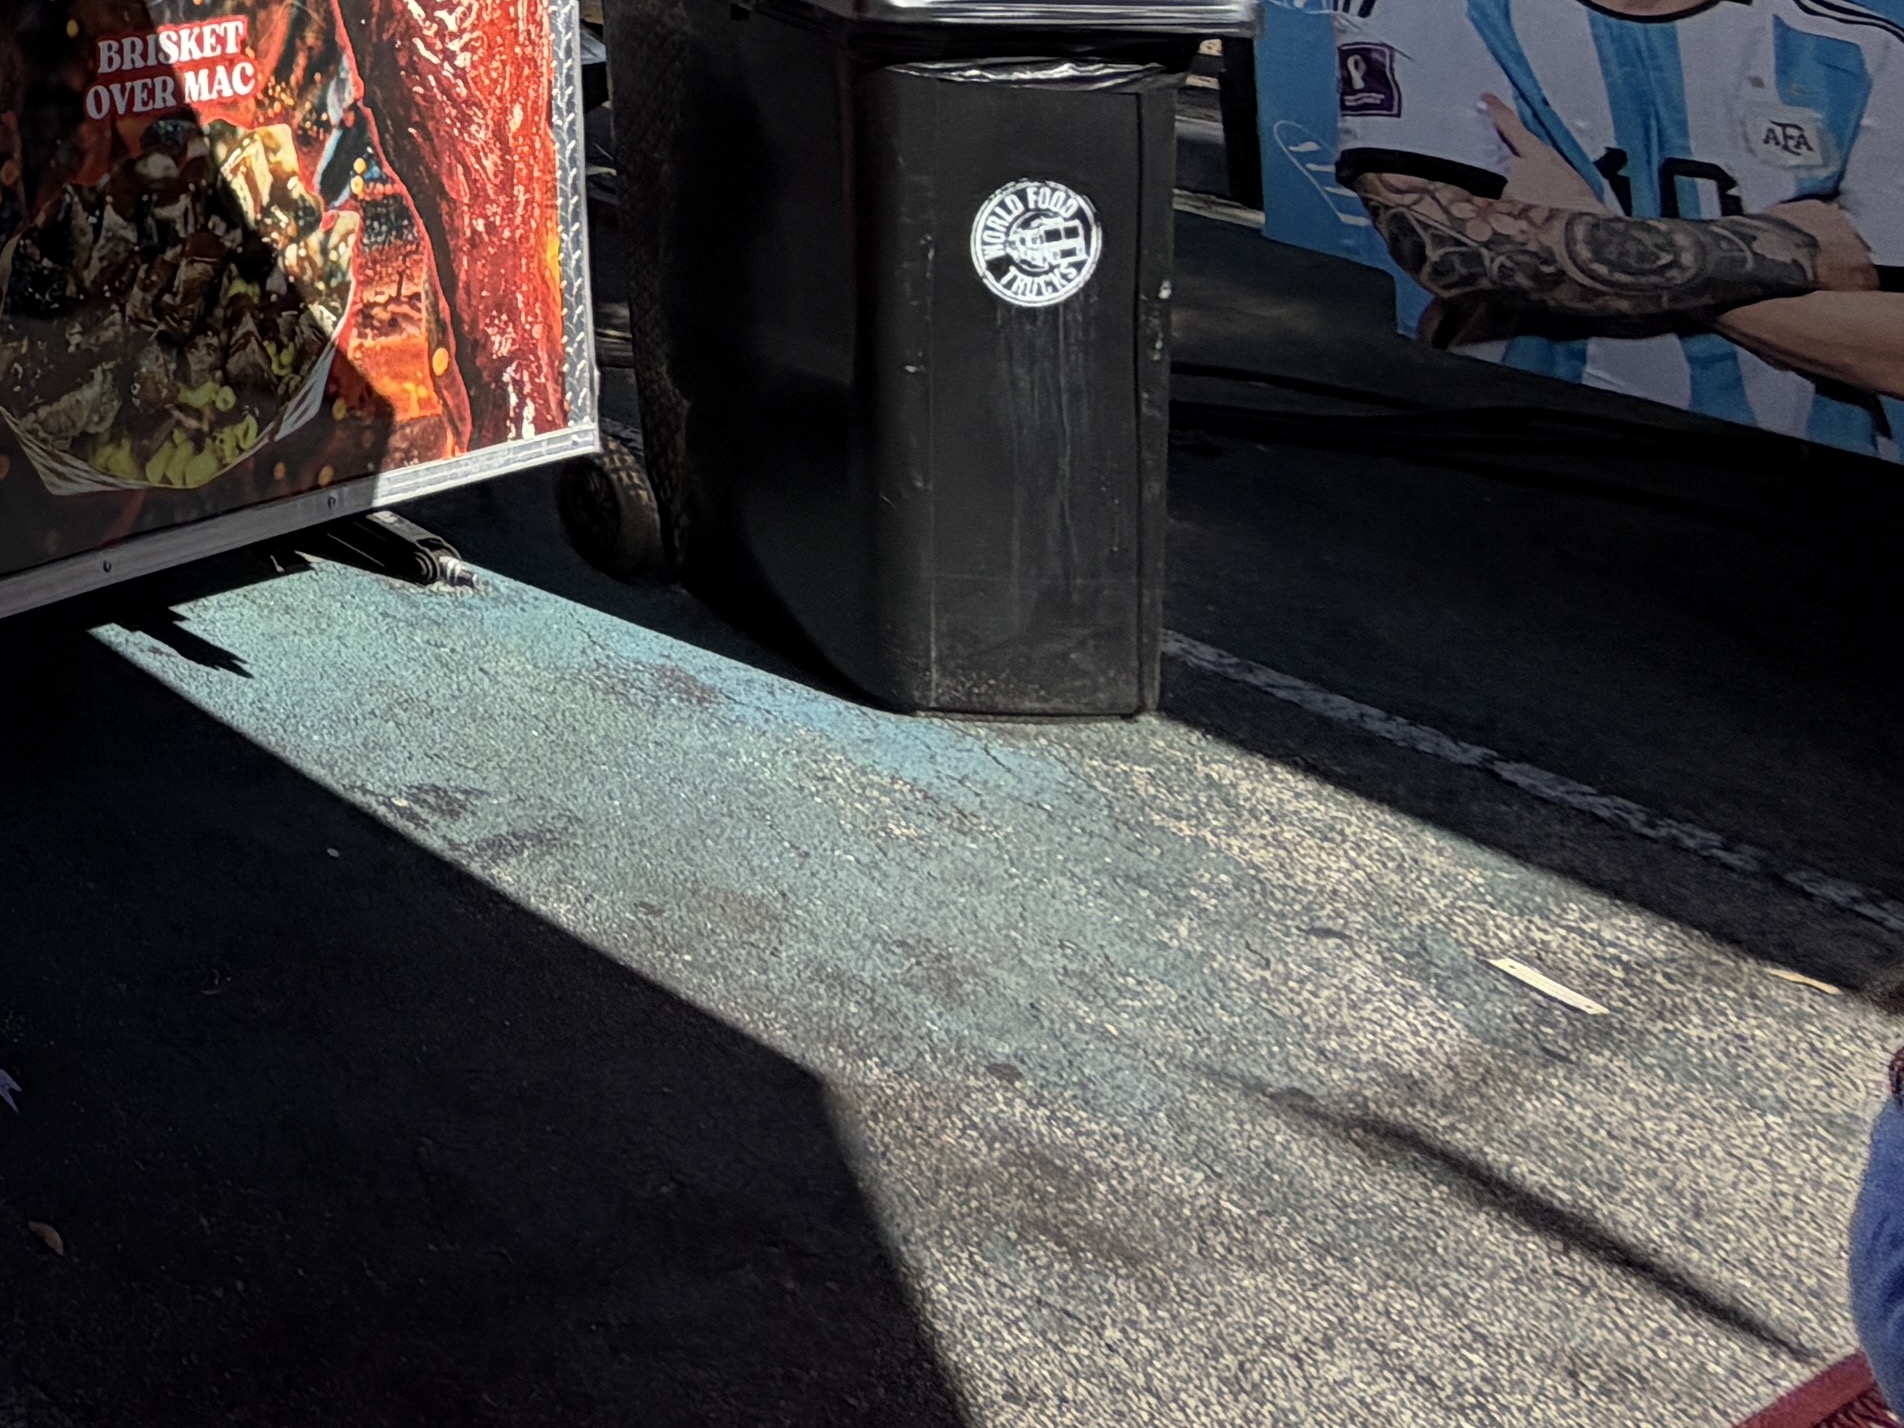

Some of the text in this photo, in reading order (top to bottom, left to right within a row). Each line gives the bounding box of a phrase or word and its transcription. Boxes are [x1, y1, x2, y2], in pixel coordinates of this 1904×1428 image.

[98, 21, 245, 74] BRISKET
[87, 61, 256, 120] OVER MAC
[982, 186, 1080, 261] WORLD FOOD
[999, 263, 1078, 296] TRUCKS
